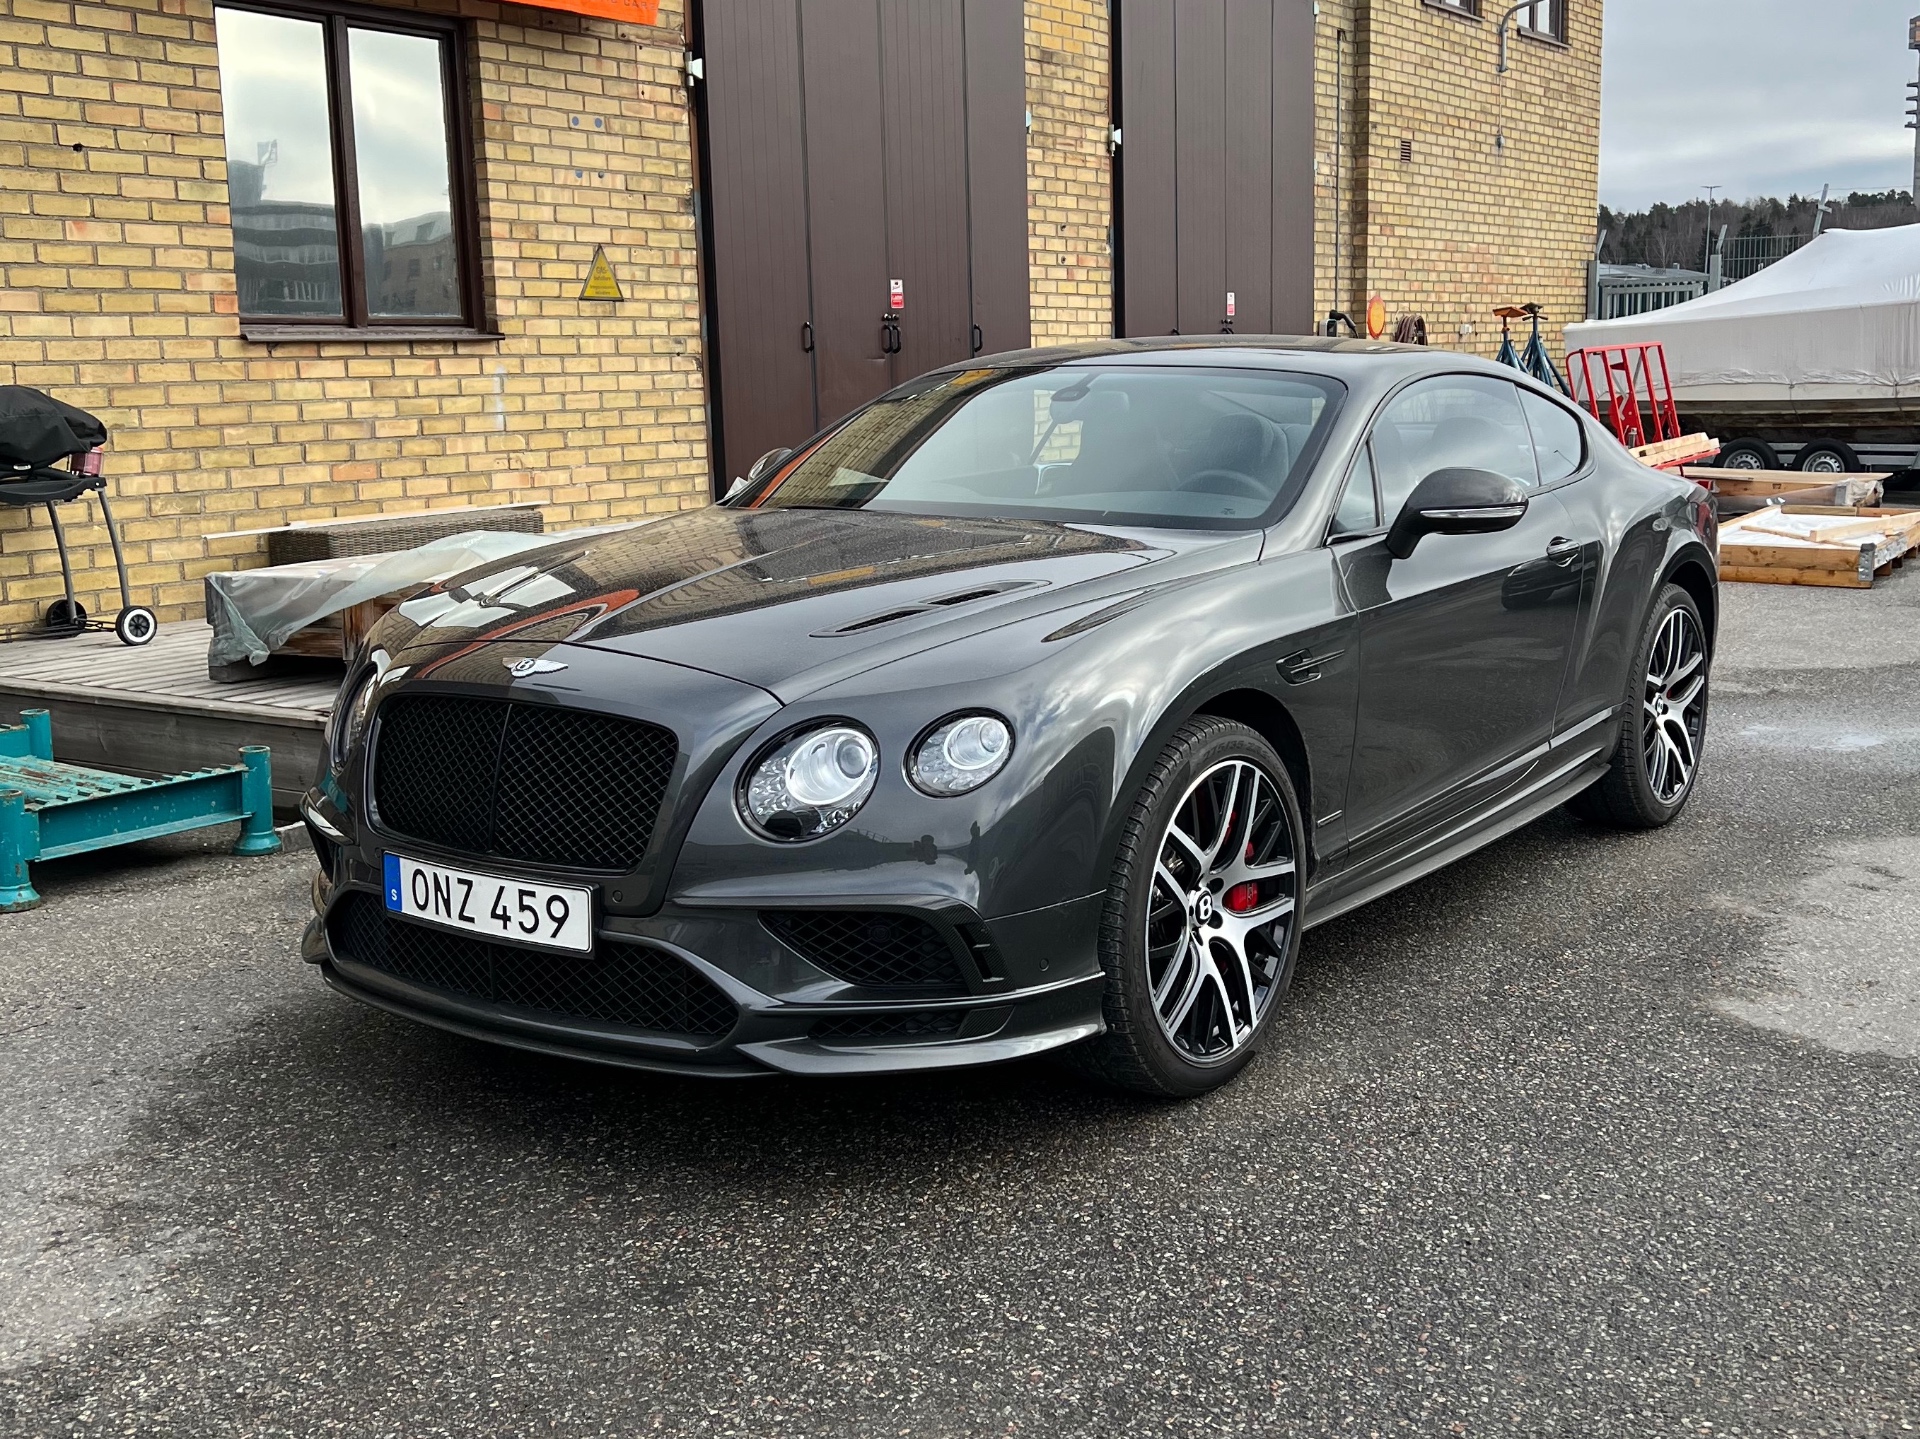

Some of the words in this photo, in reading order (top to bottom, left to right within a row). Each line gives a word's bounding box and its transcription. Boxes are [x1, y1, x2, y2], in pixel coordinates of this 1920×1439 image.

[391, 888, 398, 901] S
[411, 867, 476, 924] ONZ
[490, 885, 570, 939] 459
[1199, 895, 1213, 920] B
